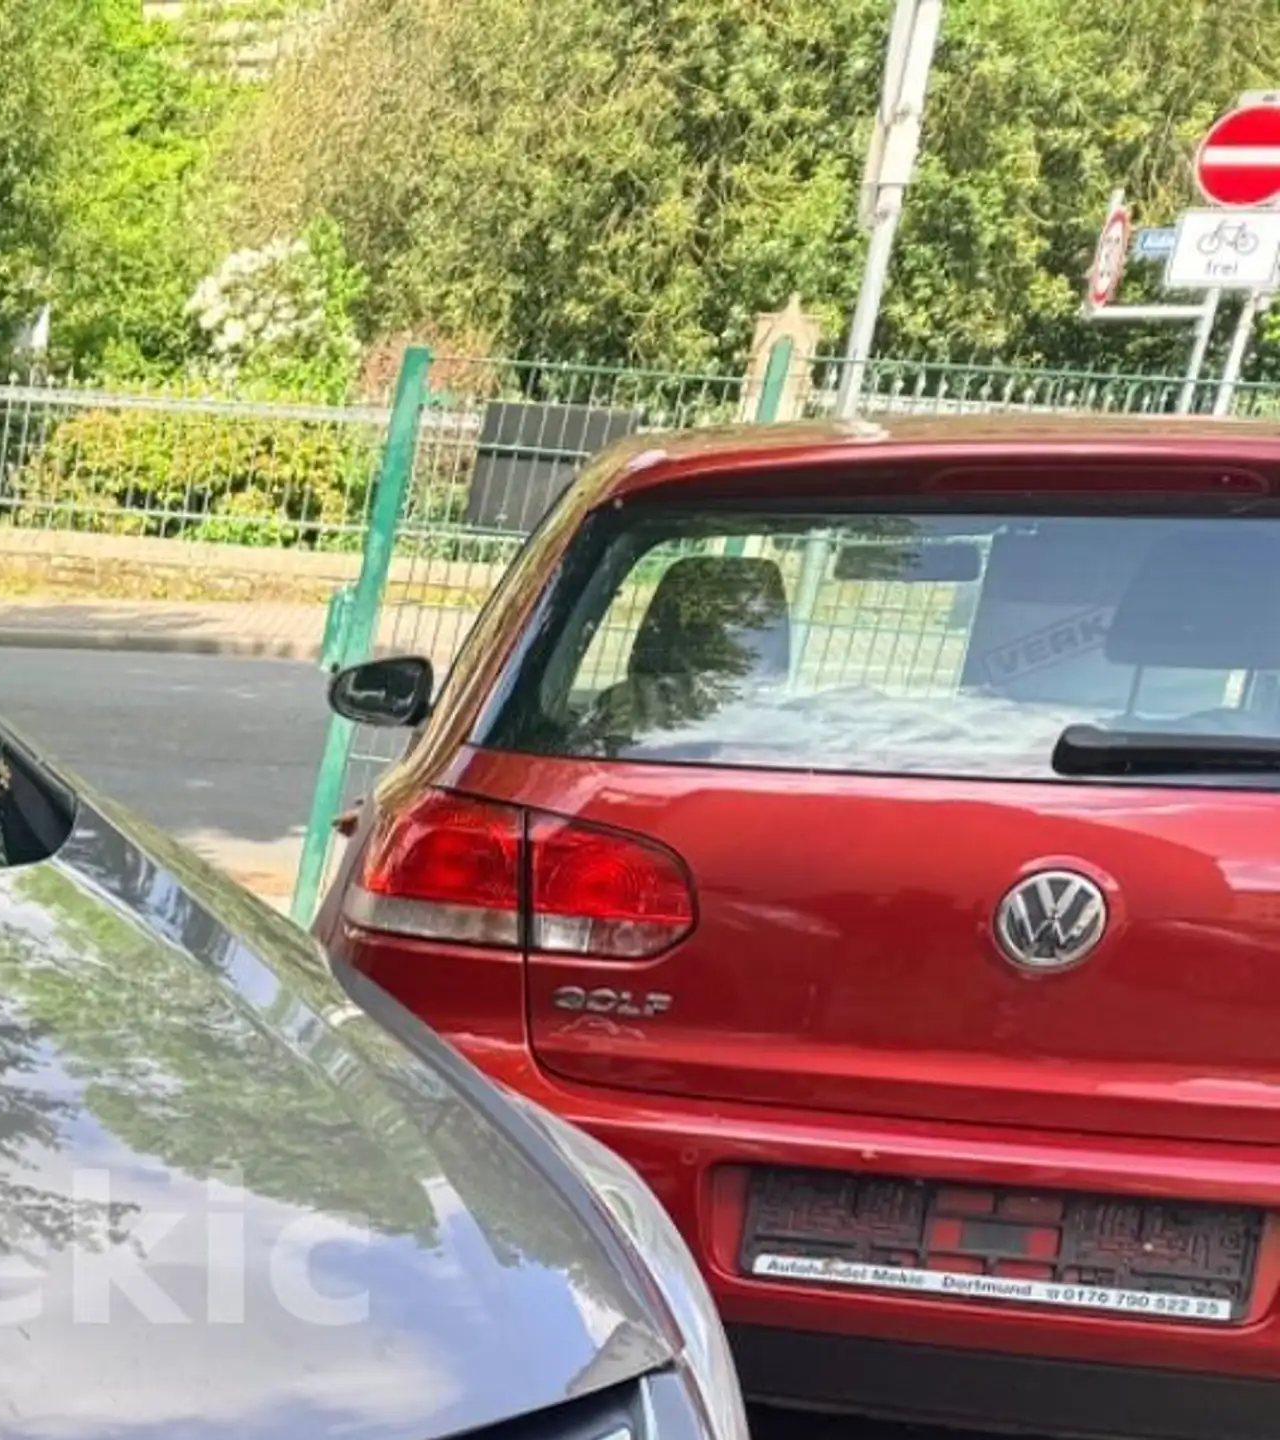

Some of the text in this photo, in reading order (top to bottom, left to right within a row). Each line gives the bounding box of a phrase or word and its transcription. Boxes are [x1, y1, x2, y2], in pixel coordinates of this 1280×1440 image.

[1206, 260, 1238, 276] frei
[553, 985, 672, 1016] GOLF
[871, 1269, 925, 1286] Mekic
[942, 1276, 1032, 1298] Dortmund
